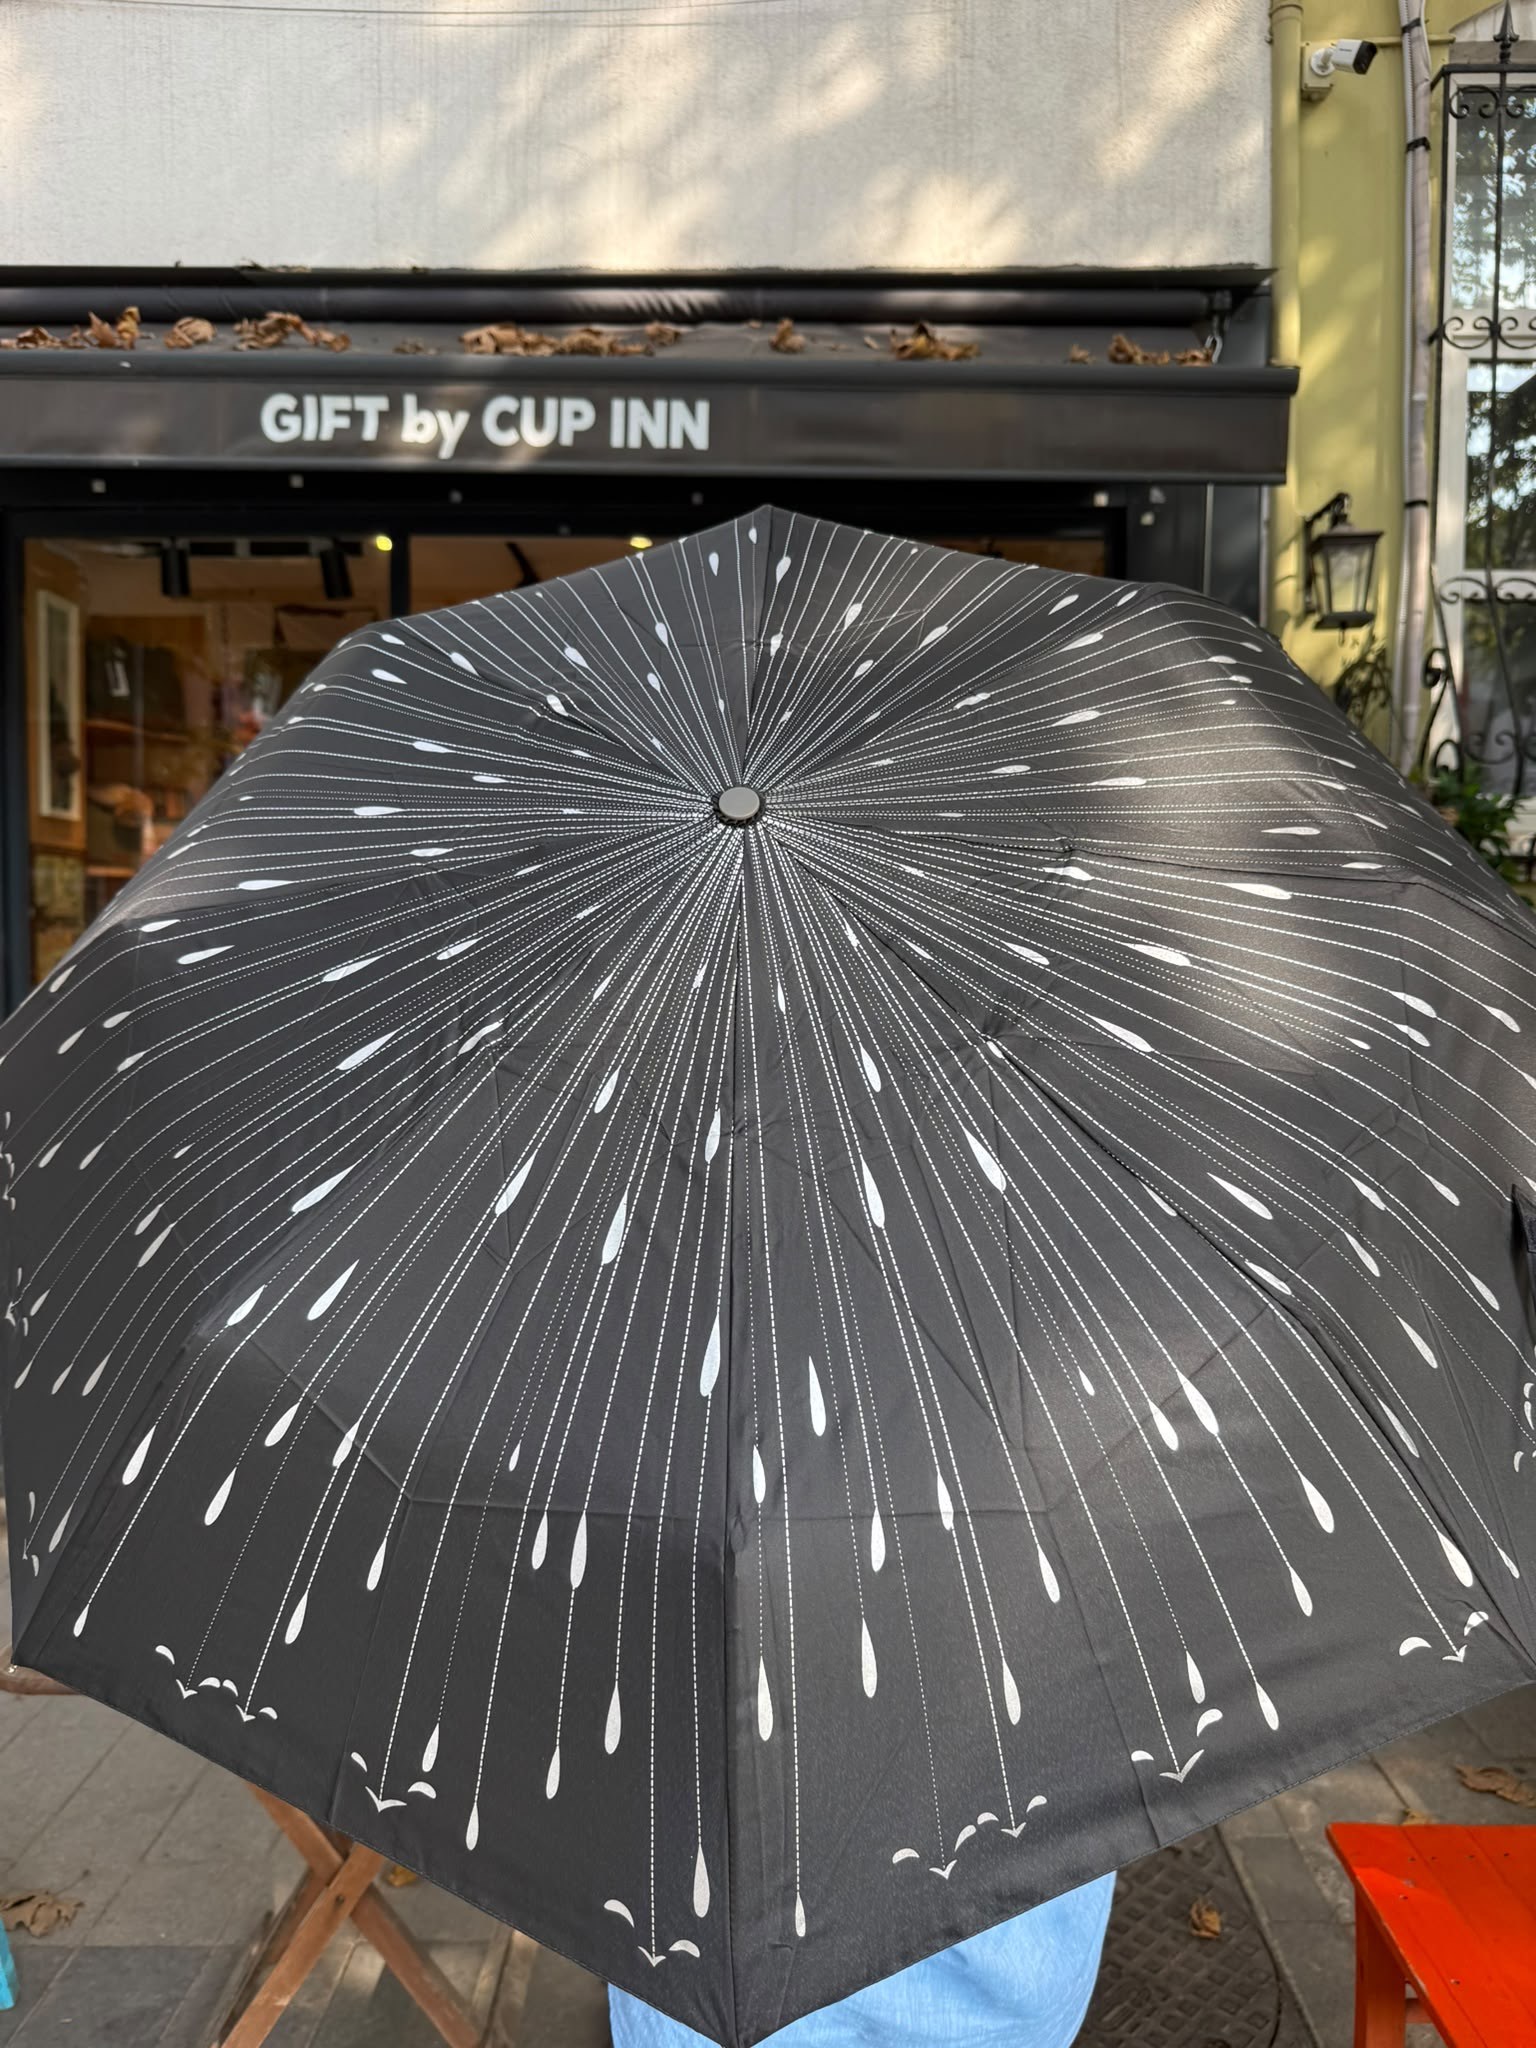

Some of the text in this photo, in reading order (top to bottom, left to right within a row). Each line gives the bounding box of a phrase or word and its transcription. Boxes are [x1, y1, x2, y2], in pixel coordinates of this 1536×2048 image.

[260, 393, 710, 460] GIFT by CUP INN
